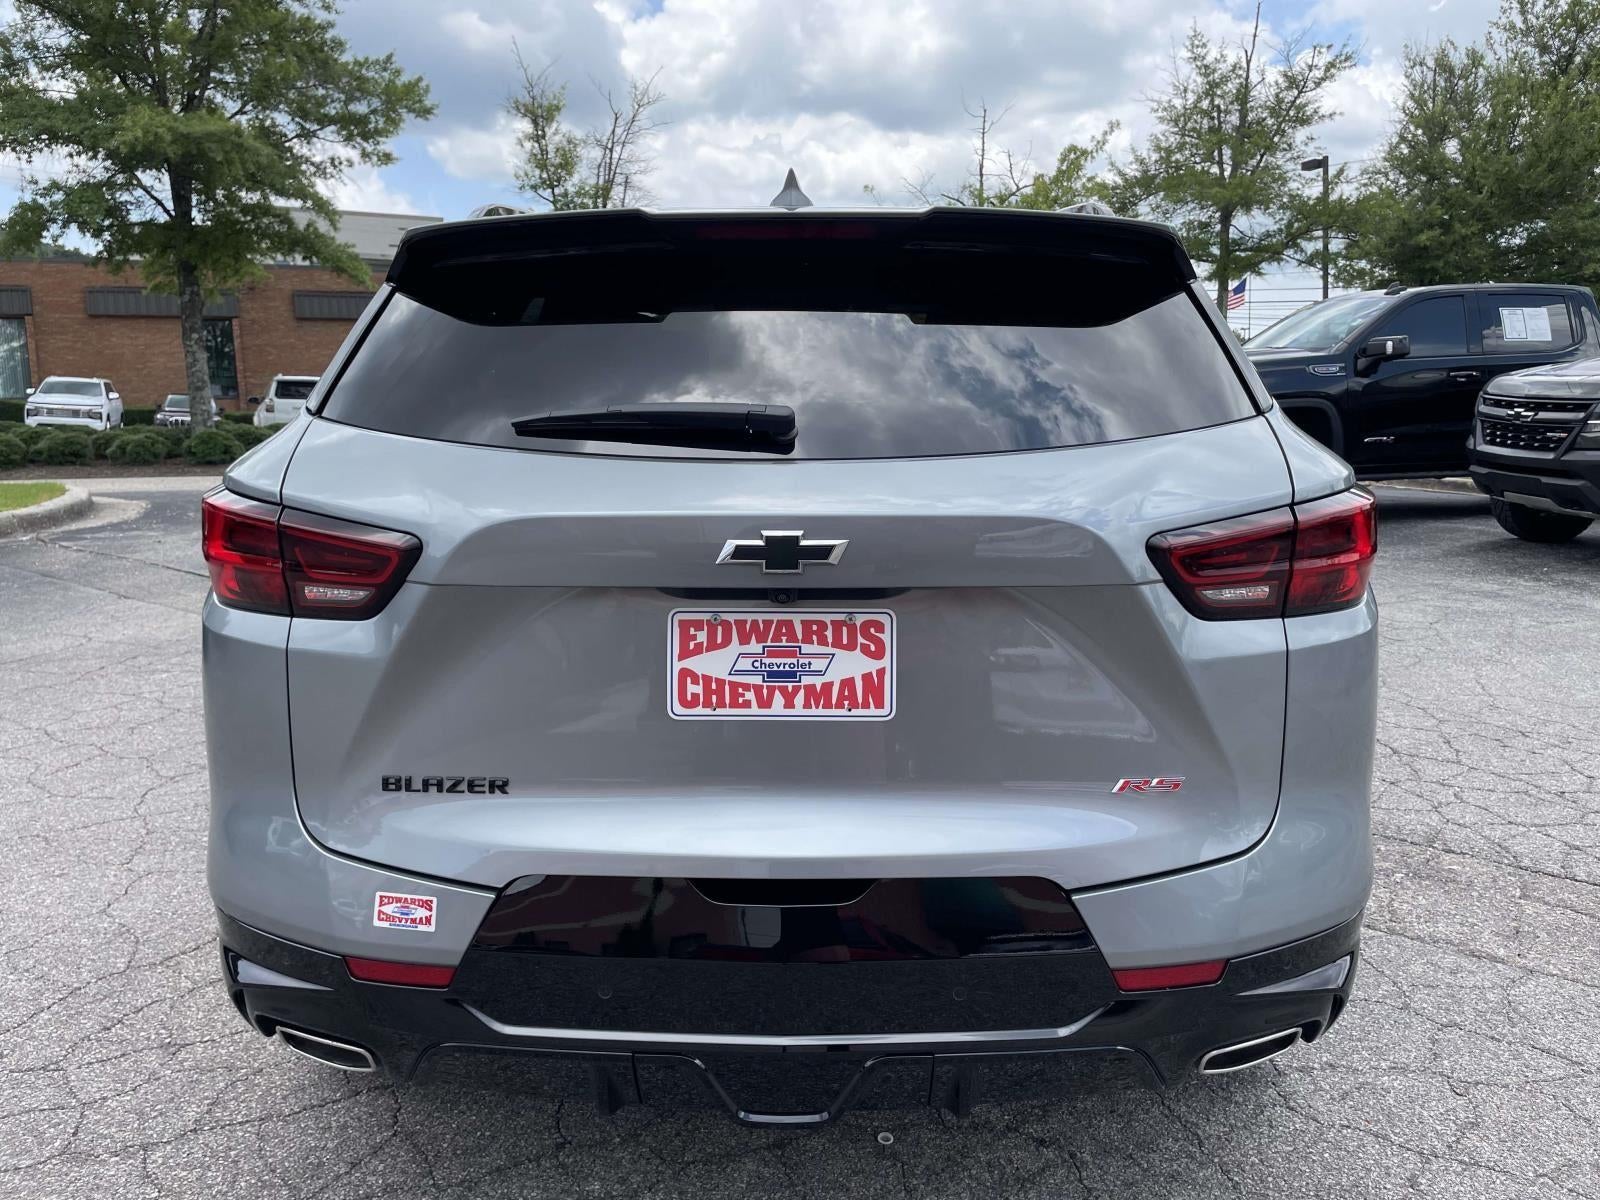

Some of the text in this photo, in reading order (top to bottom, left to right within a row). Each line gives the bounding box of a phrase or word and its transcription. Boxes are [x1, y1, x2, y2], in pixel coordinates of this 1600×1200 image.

[677, 619, 886, 662] EDWARDS
[751, 660, 812, 670] Chevrolet
[677, 666, 886, 709] CHEVYMAN
[382, 775, 509, 794] BLAZER
[1111, 777, 1185, 793] RS
[378, 895, 433, 912] EDWARDS
[377, 909, 432, 926] CHEVYMAN
